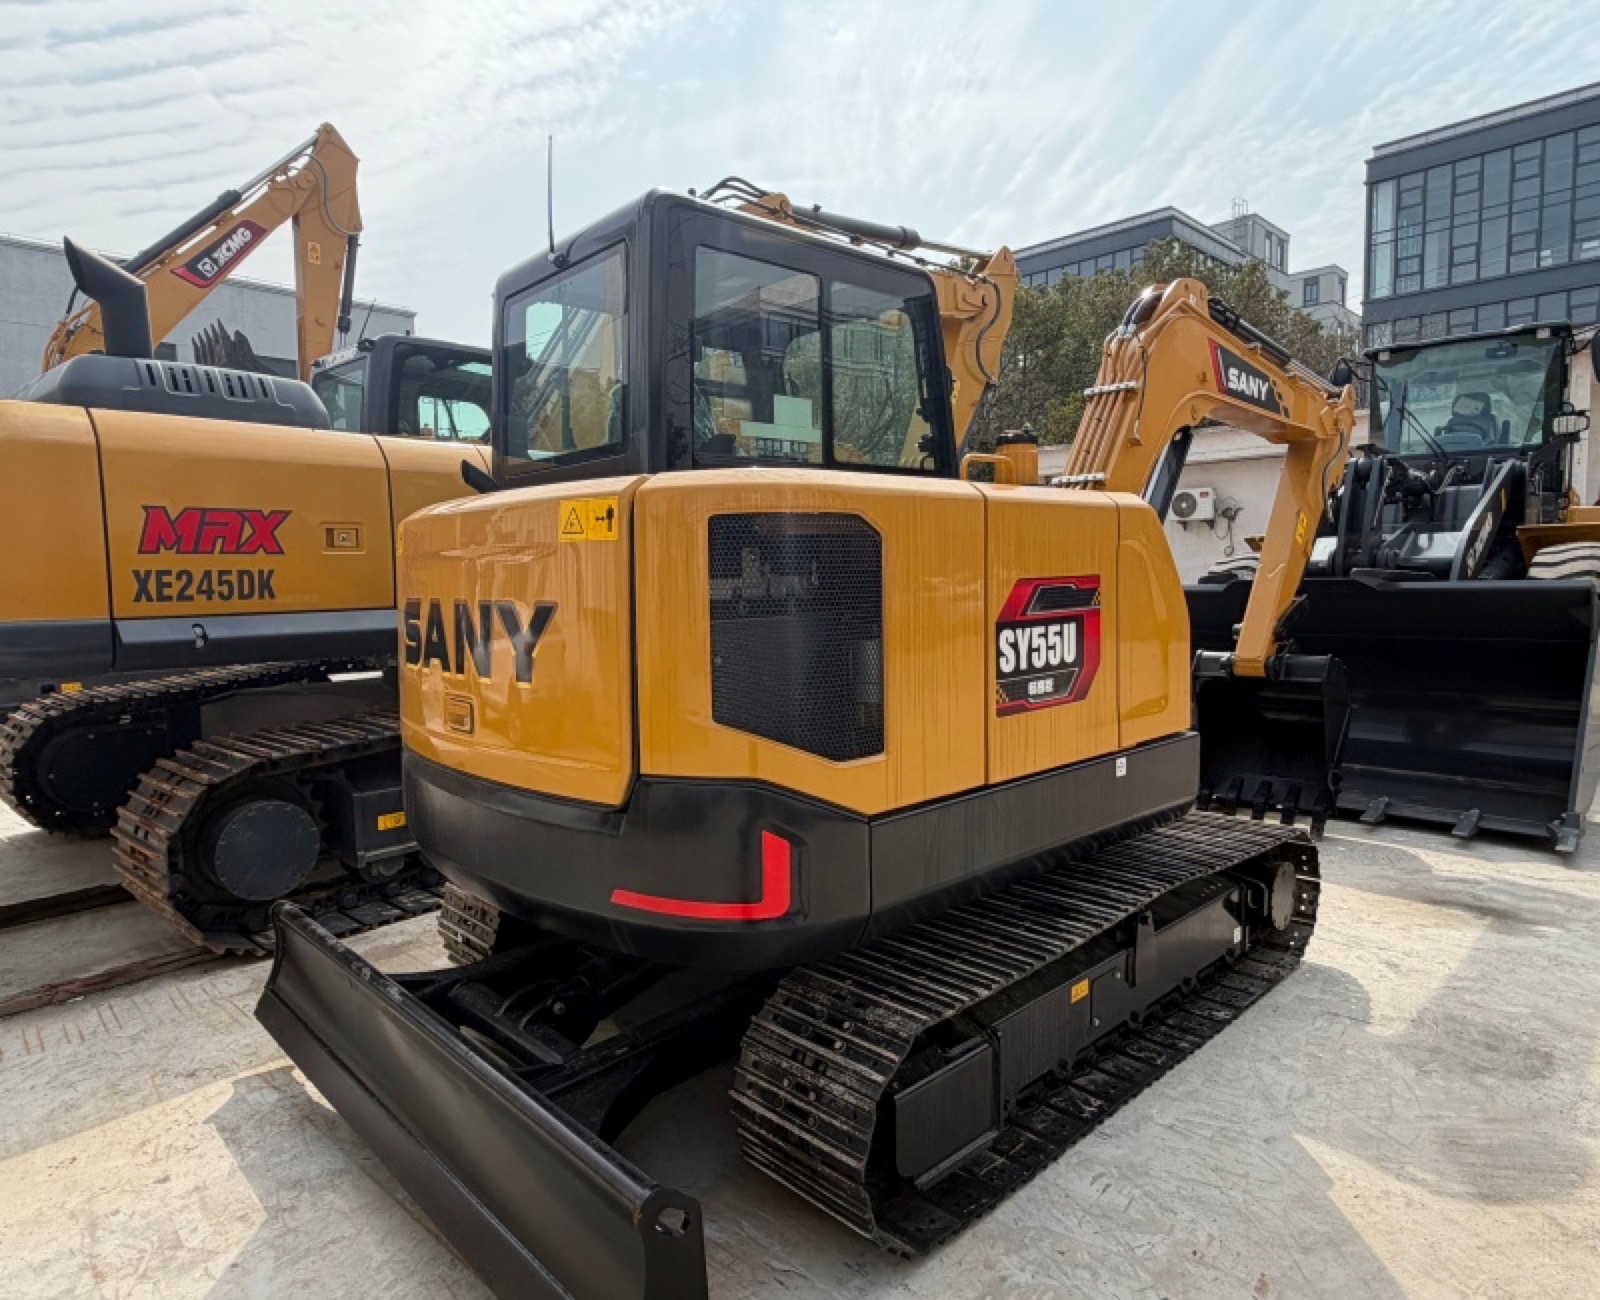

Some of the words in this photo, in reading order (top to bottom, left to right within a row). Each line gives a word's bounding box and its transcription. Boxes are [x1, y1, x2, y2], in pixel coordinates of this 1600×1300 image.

[212, 227, 253, 267] XCMG
[1228, 367, 1269, 401] SANY
[138, 505, 293, 555] MAX
[132, 569, 277, 602] XE245DK
[405, 598, 558, 688] SANY
[999, 621, 1077, 673] SY55U
